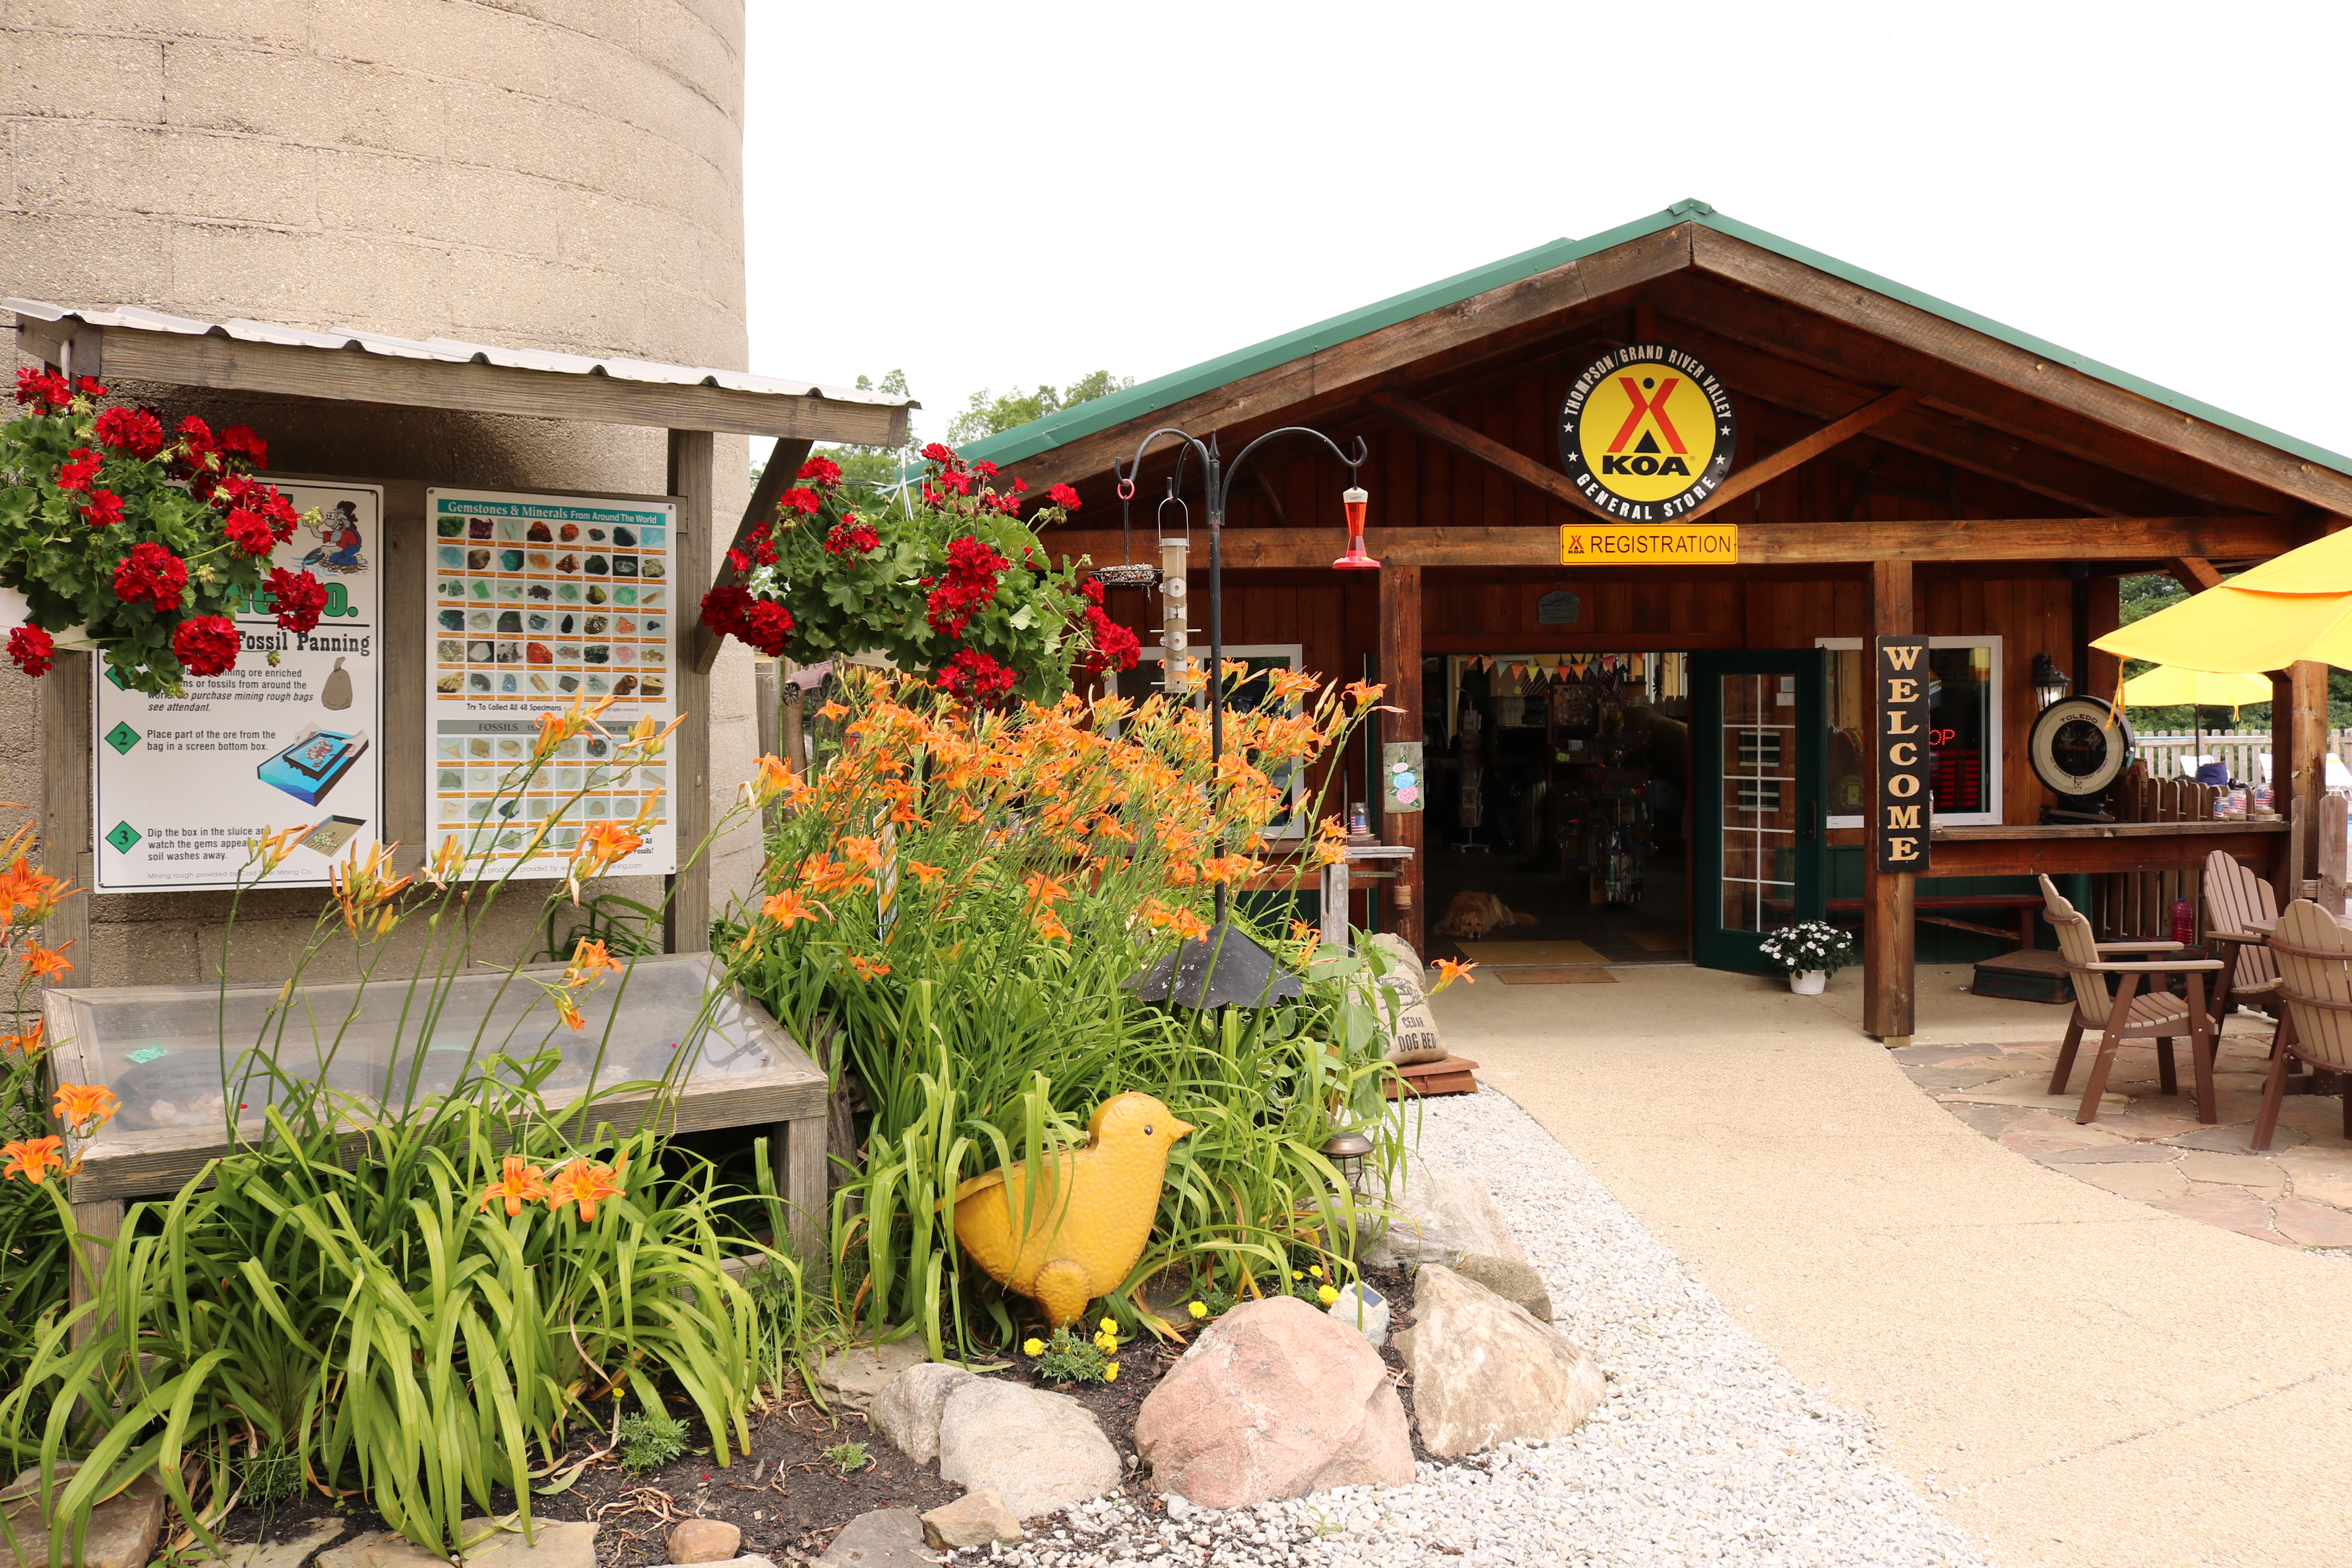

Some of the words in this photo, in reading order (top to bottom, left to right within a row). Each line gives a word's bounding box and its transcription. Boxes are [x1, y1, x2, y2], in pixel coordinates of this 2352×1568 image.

[1564, 345, 1664, 415] THOMPSON/GRAND
[1668, 350, 1704, 378] RIVER
[1703, 375, 1732, 419] VALLEY
[1602, 455, 1691, 476] KOA
[1576, 473, 1652, 520] GENERAL
[1664, 476, 1716, 517] STORE
[448, 502, 508, 515] Gemstones
[511, 505, 518, 515] &
[522, 507, 567, 519] Minerals
[571, 510, 590, 520] From
[592, 512, 619, 522] Around
[621, 514, 634, 522] The
[636, 514, 656, 524] World
[1591, 536, 1731, 553] REGISTRATION
[322, 582, 358, 617] O.
[297, 633, 370, 656] Panning
[266, 669, 302, 677] enriched
[208, 680, 236, 688] fossils
[239, 680, 259, 688] from
[191, 692, 231, 701] purchase
[234, 692, 263, 702] mining
[266, 693, 290, 702] rough
[293, 692, 313, 702] bags
[167, 703, 211, 711] attendant.
[2060, 714, 2098, 724] TOLEDO
[118, 731, 128, 746] 2
[147, 730, 172, 739] Place
[175, 730, 193, 740] part
[196, 730, 204, 739] of
[207, 730, 220, 739] the
[223, 731, 237, 739] ore
[240, 730, 260, 739] from
[262, 730, 276, 739] the
[147, 742, 163, 753] bag
[166, 742, 174, 750] in
[218, 741, 249, 751] bottom
[251, 741, 269, 751] box.
[1883, 646, 1922, 861] WELCOME
[2054, 765, 2072, 779] SPRINGS
[2096, 758, 2109, 774] WEIGHT
[119, 830, 129, 845] 3
[148, 828, 162, 838] Dip
[165, 828, 179, 837] the
[182, 828, 197, 836] box
[227, 827, 252, 835] sluice
[148, 841, 174, 849] watch
[178, 840, 191, 848] the
[194, 841, 218, 850] gems
[221, 841, 248, 849] appea
[148, 852, 164, 861] soil
[203, 852, 227, 861] away.
[1402, 1017, 1425, 1028] CEDAR
[1397, 1034, 1419, 1052] DOG
[1422, 1033, 1436, 1049] BED
